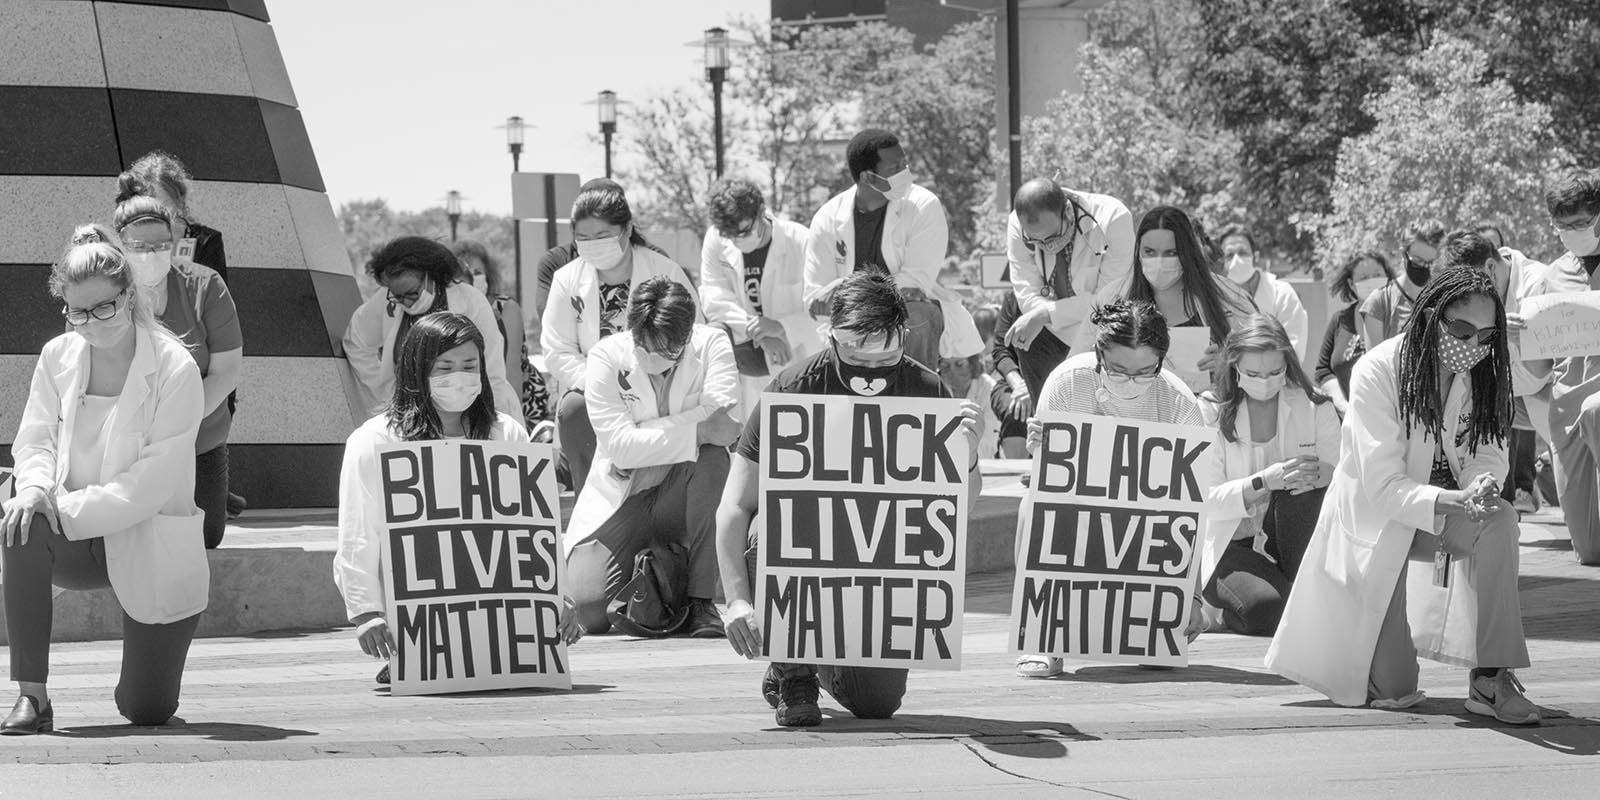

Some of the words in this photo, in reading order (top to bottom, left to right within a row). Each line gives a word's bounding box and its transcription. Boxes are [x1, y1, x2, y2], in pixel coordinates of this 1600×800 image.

[380, 444, 554, 523] BLACK
[769, 403, 967, 485] BLACK
[1037, 422, 1212, 502] BLACK
[401, 529, 556, 591] LIVES
[779, 496, 956, 567] LIVES
[1038, 510, 1197, 575] LIVES
[396, 598, 565, 681] MATTER
[762, 574, 953, 660] MATTER
[1017, 577, 1185, 656] MATTER
